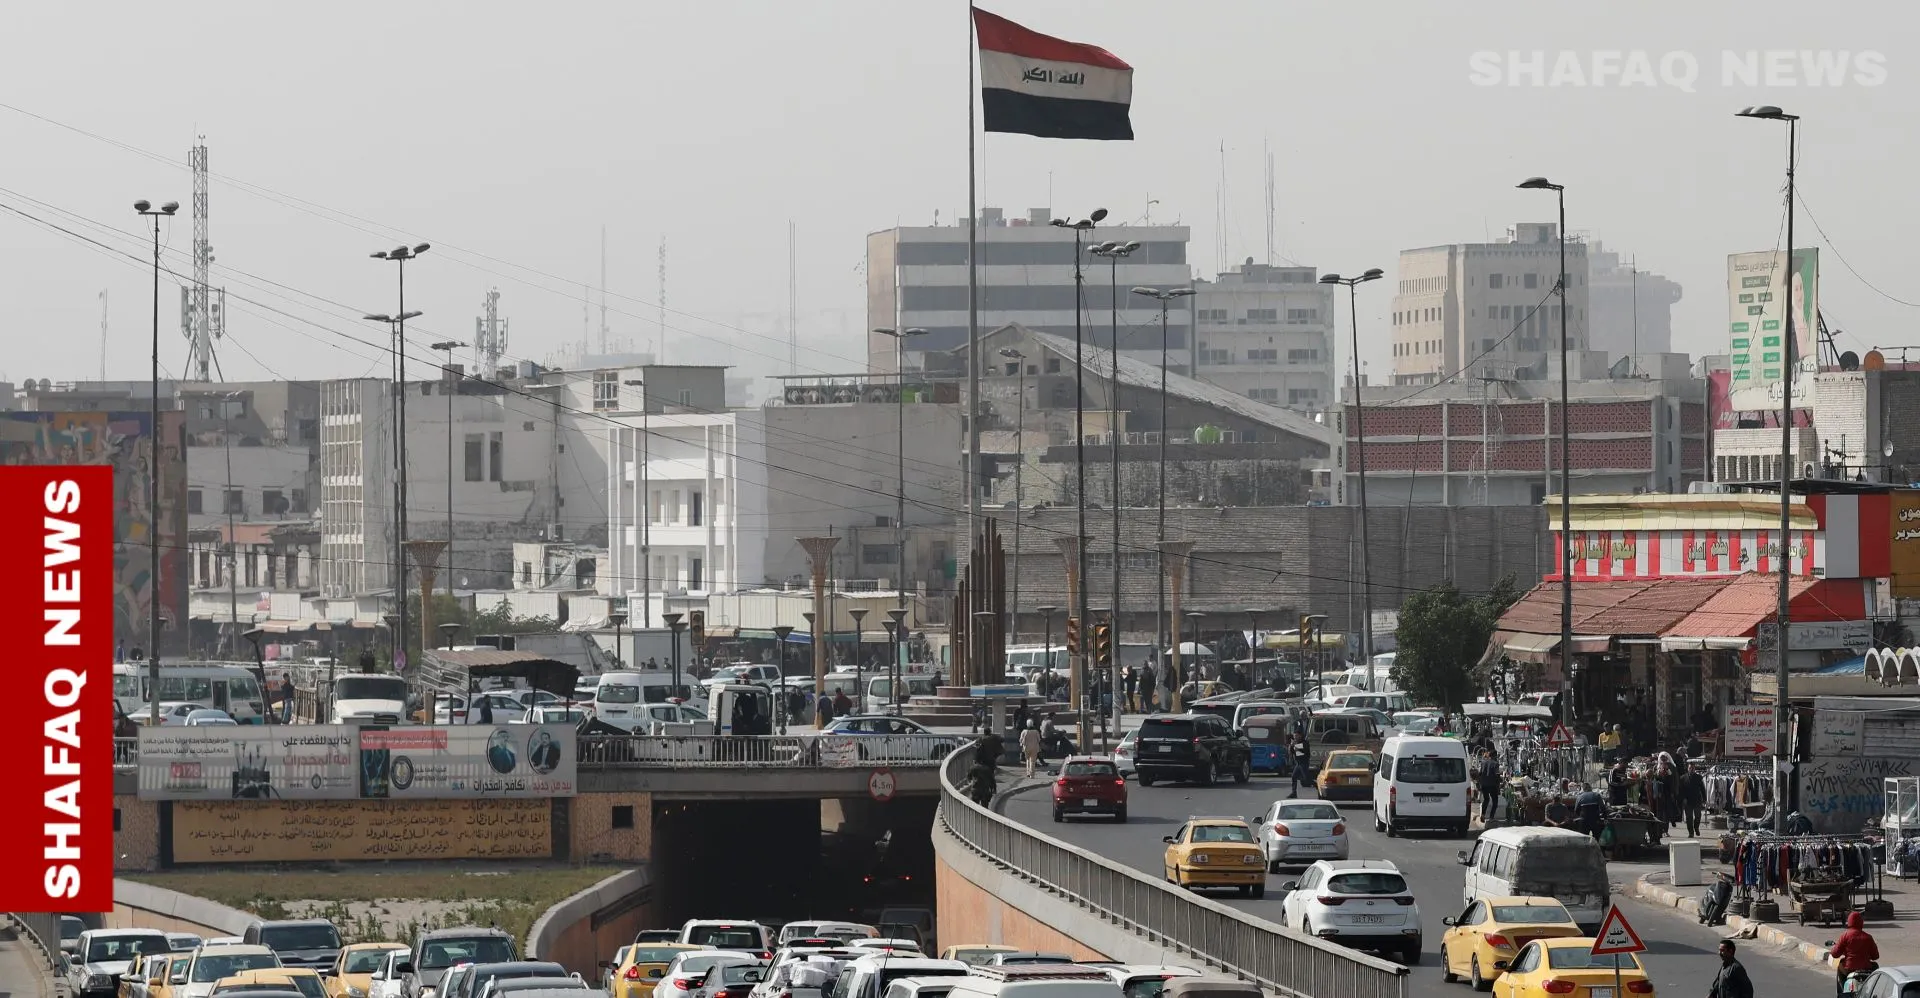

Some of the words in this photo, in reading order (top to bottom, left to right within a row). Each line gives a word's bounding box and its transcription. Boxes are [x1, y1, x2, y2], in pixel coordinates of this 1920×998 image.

[1058, 72, 1085, 85] الله
[282, 752, 331, 768] المخدرات
[473, 779, 503, 794] المخدرات
[871, 779, 893, 790] 4.5m
[1610, 928, 1624, 936] خفف
